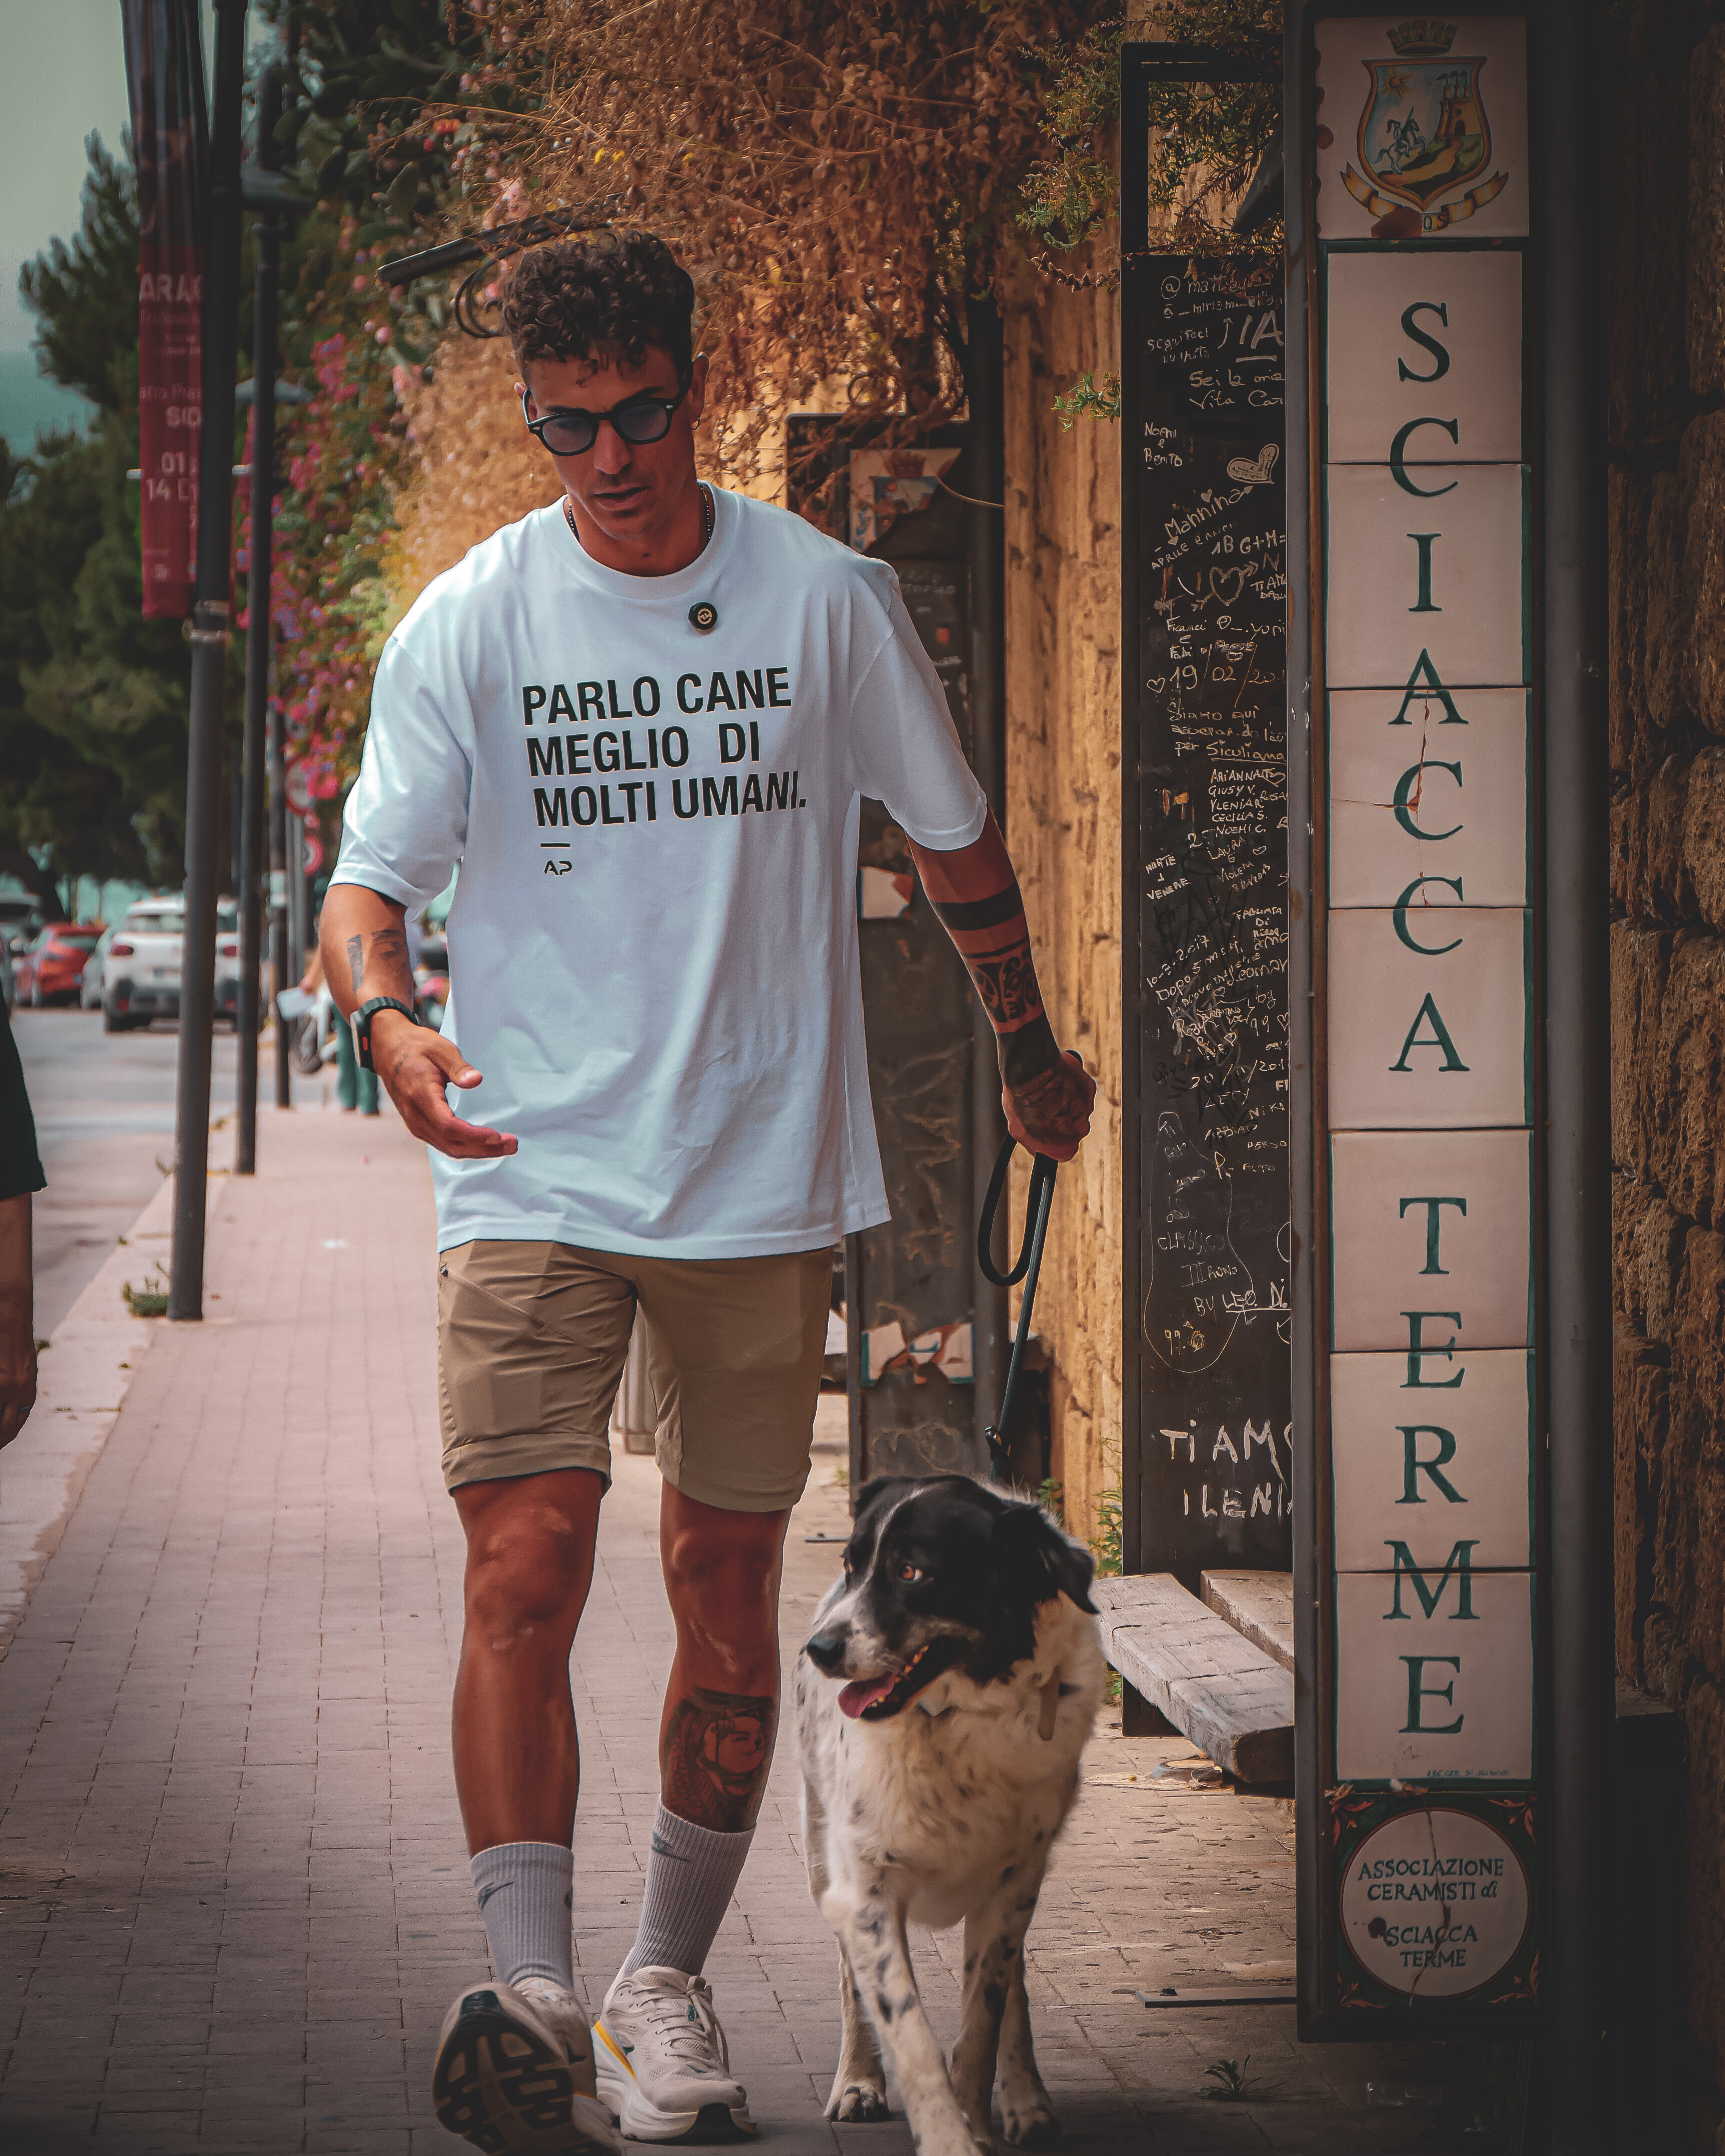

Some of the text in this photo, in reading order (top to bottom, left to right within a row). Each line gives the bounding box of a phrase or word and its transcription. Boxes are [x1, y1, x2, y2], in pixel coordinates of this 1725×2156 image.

[522, 667, 792, 725] PARLO CANE
[1389, 301, 1469, 1072] SCIACCA
[526, 721, 759, 776] MEGLIO DI
[533, 770, 807, 827] MOLTI UMANI.
[1382, 1197, 1480, 1734] TERME
[1357, 1859, 1504, 1881] ASSOCIAZIONE
[1367, 1880, 1498, 1901] CERAMISTI di
[1386, 1925, 1478, 1947] SCIACCA
[1400, 1949, 1466, 1968] TERME
